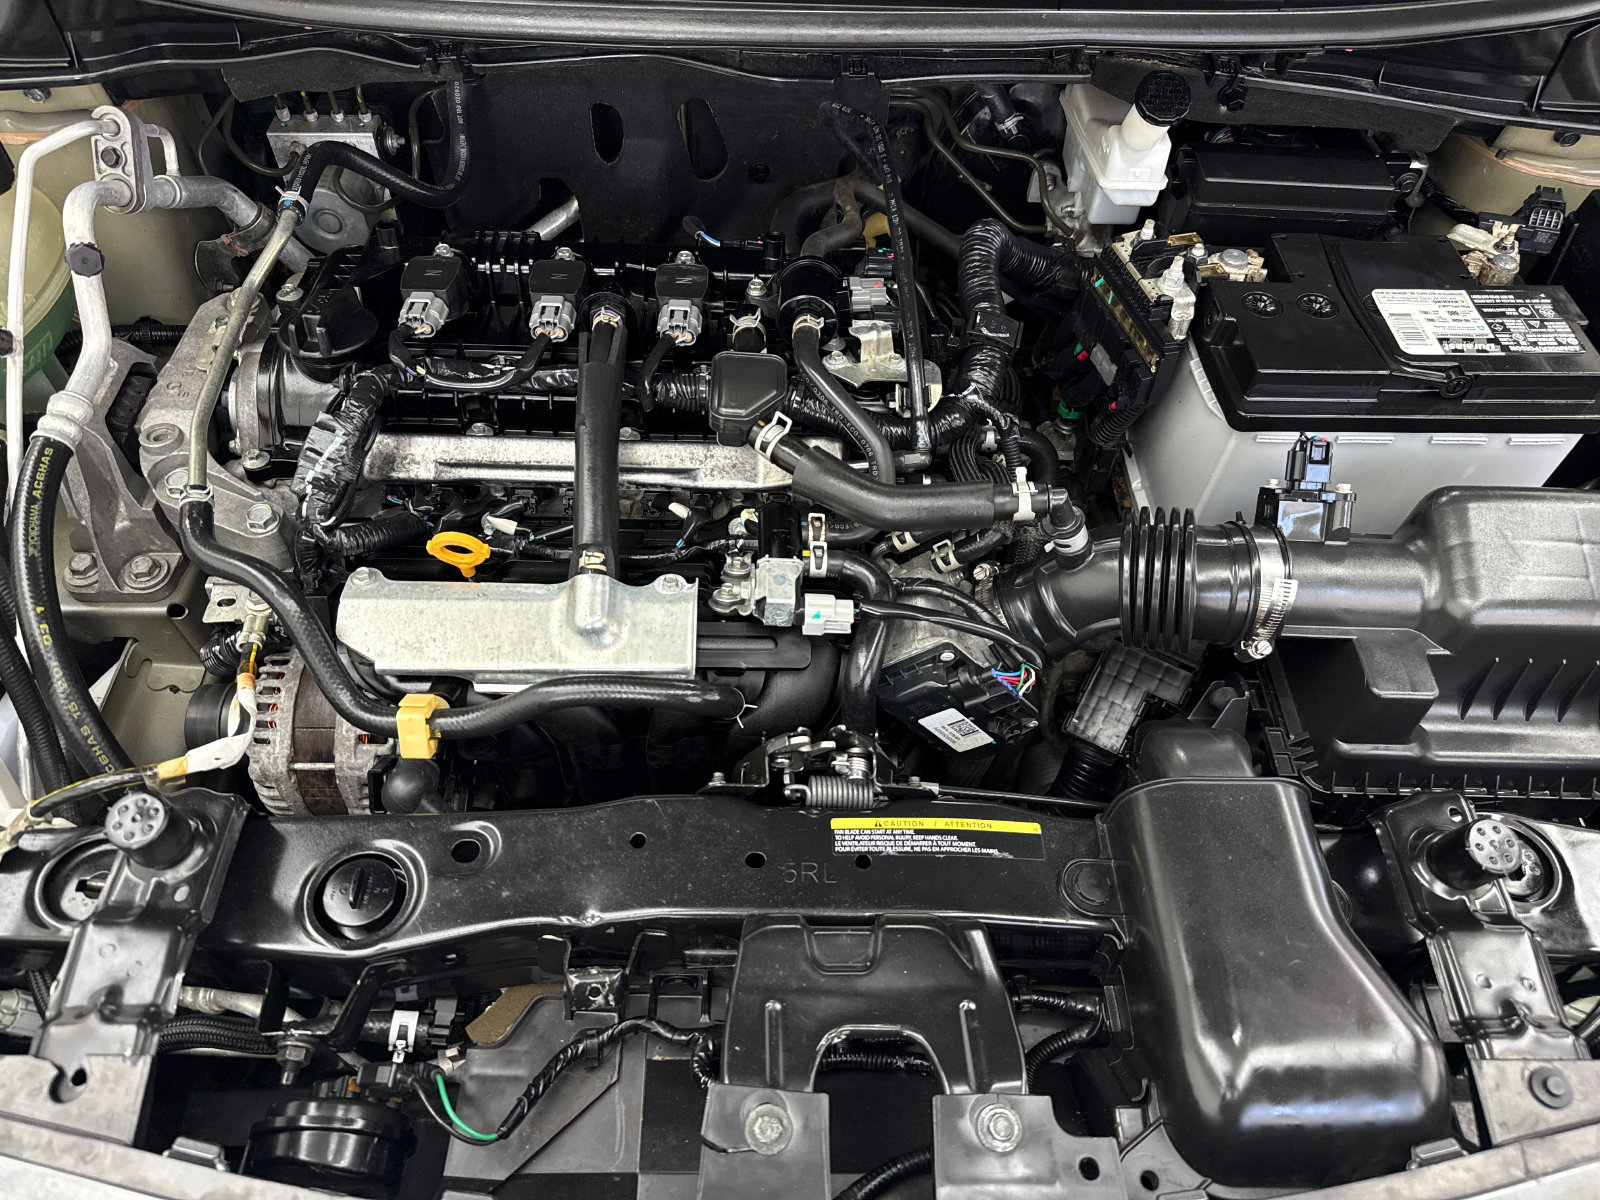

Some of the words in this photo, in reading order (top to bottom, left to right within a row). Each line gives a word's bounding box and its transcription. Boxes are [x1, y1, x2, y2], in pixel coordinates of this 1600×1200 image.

[1443, 343, 1495, 351] Duralast
[32, 447, 54, 499] AC6HAS
[28, 504, 39, 547] YOKOHAMA
[944, 821, 993, 829] ATTENTION
[904, 839, 932, 847] DÉMARRER
